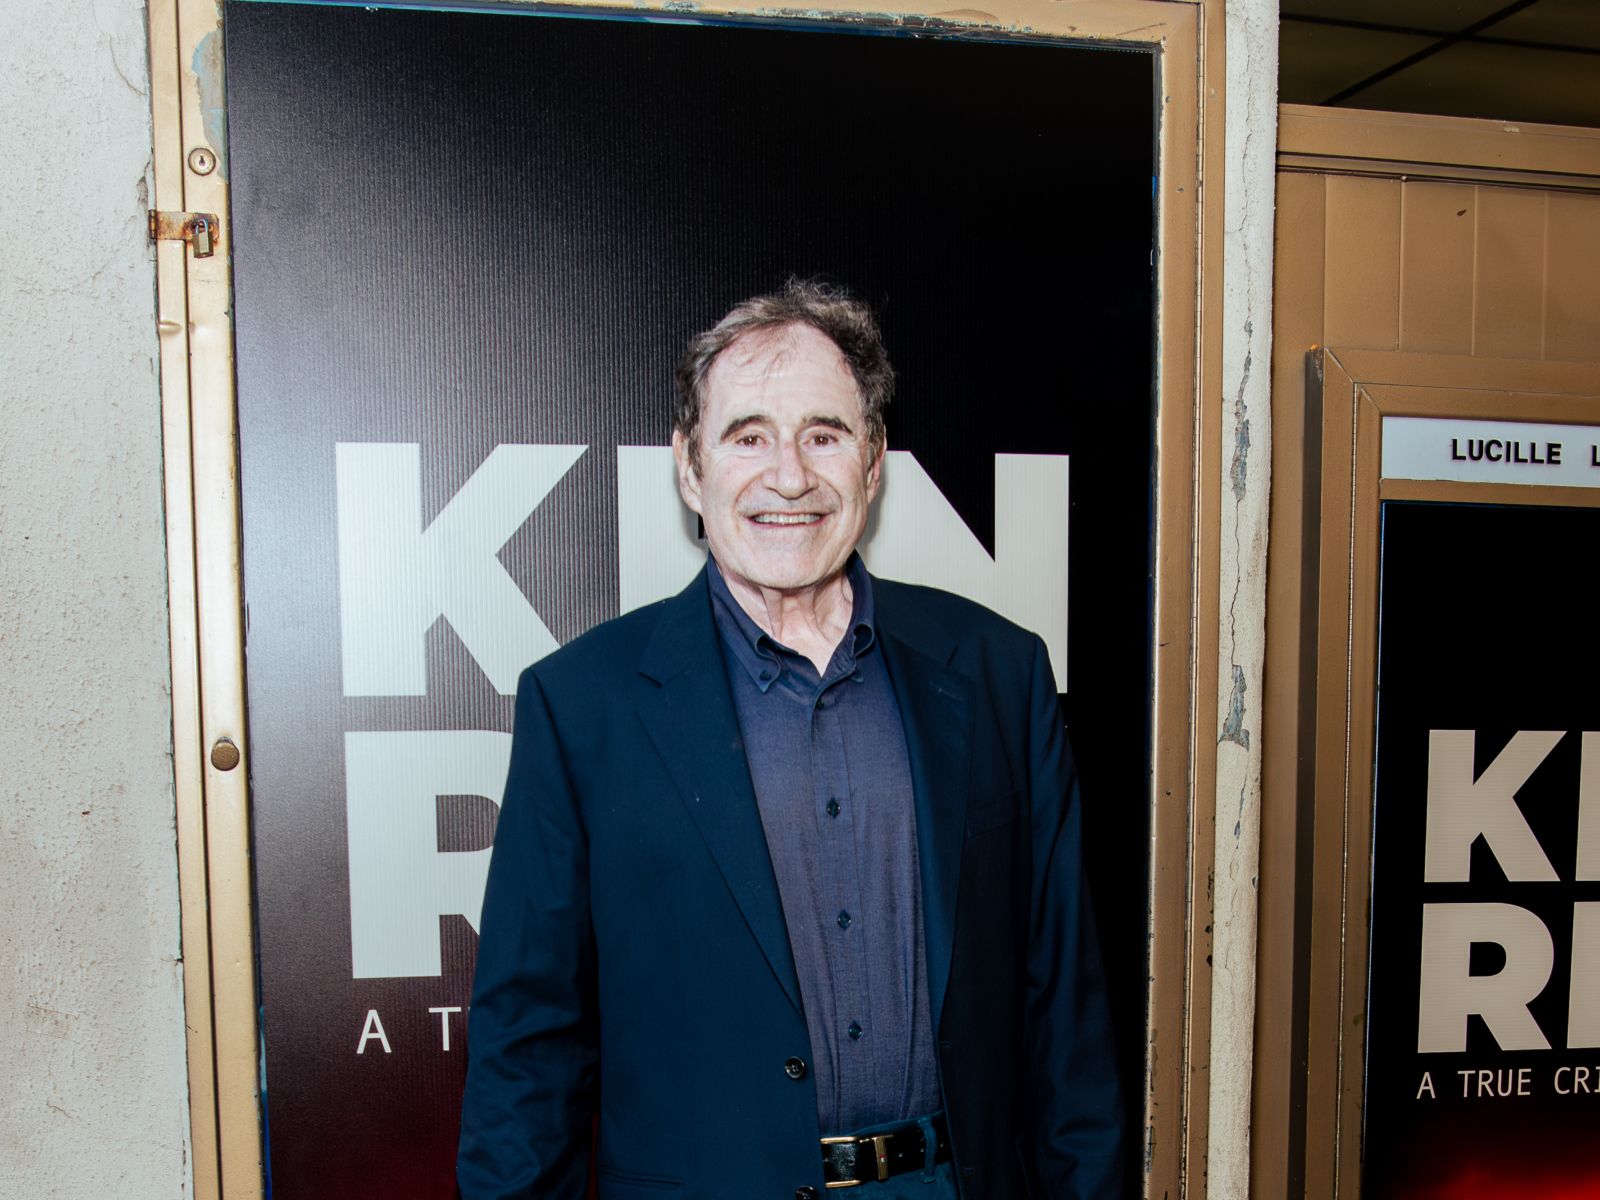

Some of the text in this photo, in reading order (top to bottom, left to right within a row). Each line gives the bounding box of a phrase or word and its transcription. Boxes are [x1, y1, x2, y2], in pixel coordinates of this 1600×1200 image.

[1451, 438, 1562, 465] LUCILLE
[1424, 729, 1600, 882] K
[1417, 902, 1600, 1053] R
[356, 1009, 392, 1054] A
[1416, 1071, 1437, 1100] A
[1457, 1068, 1532, 1098] TRUE
